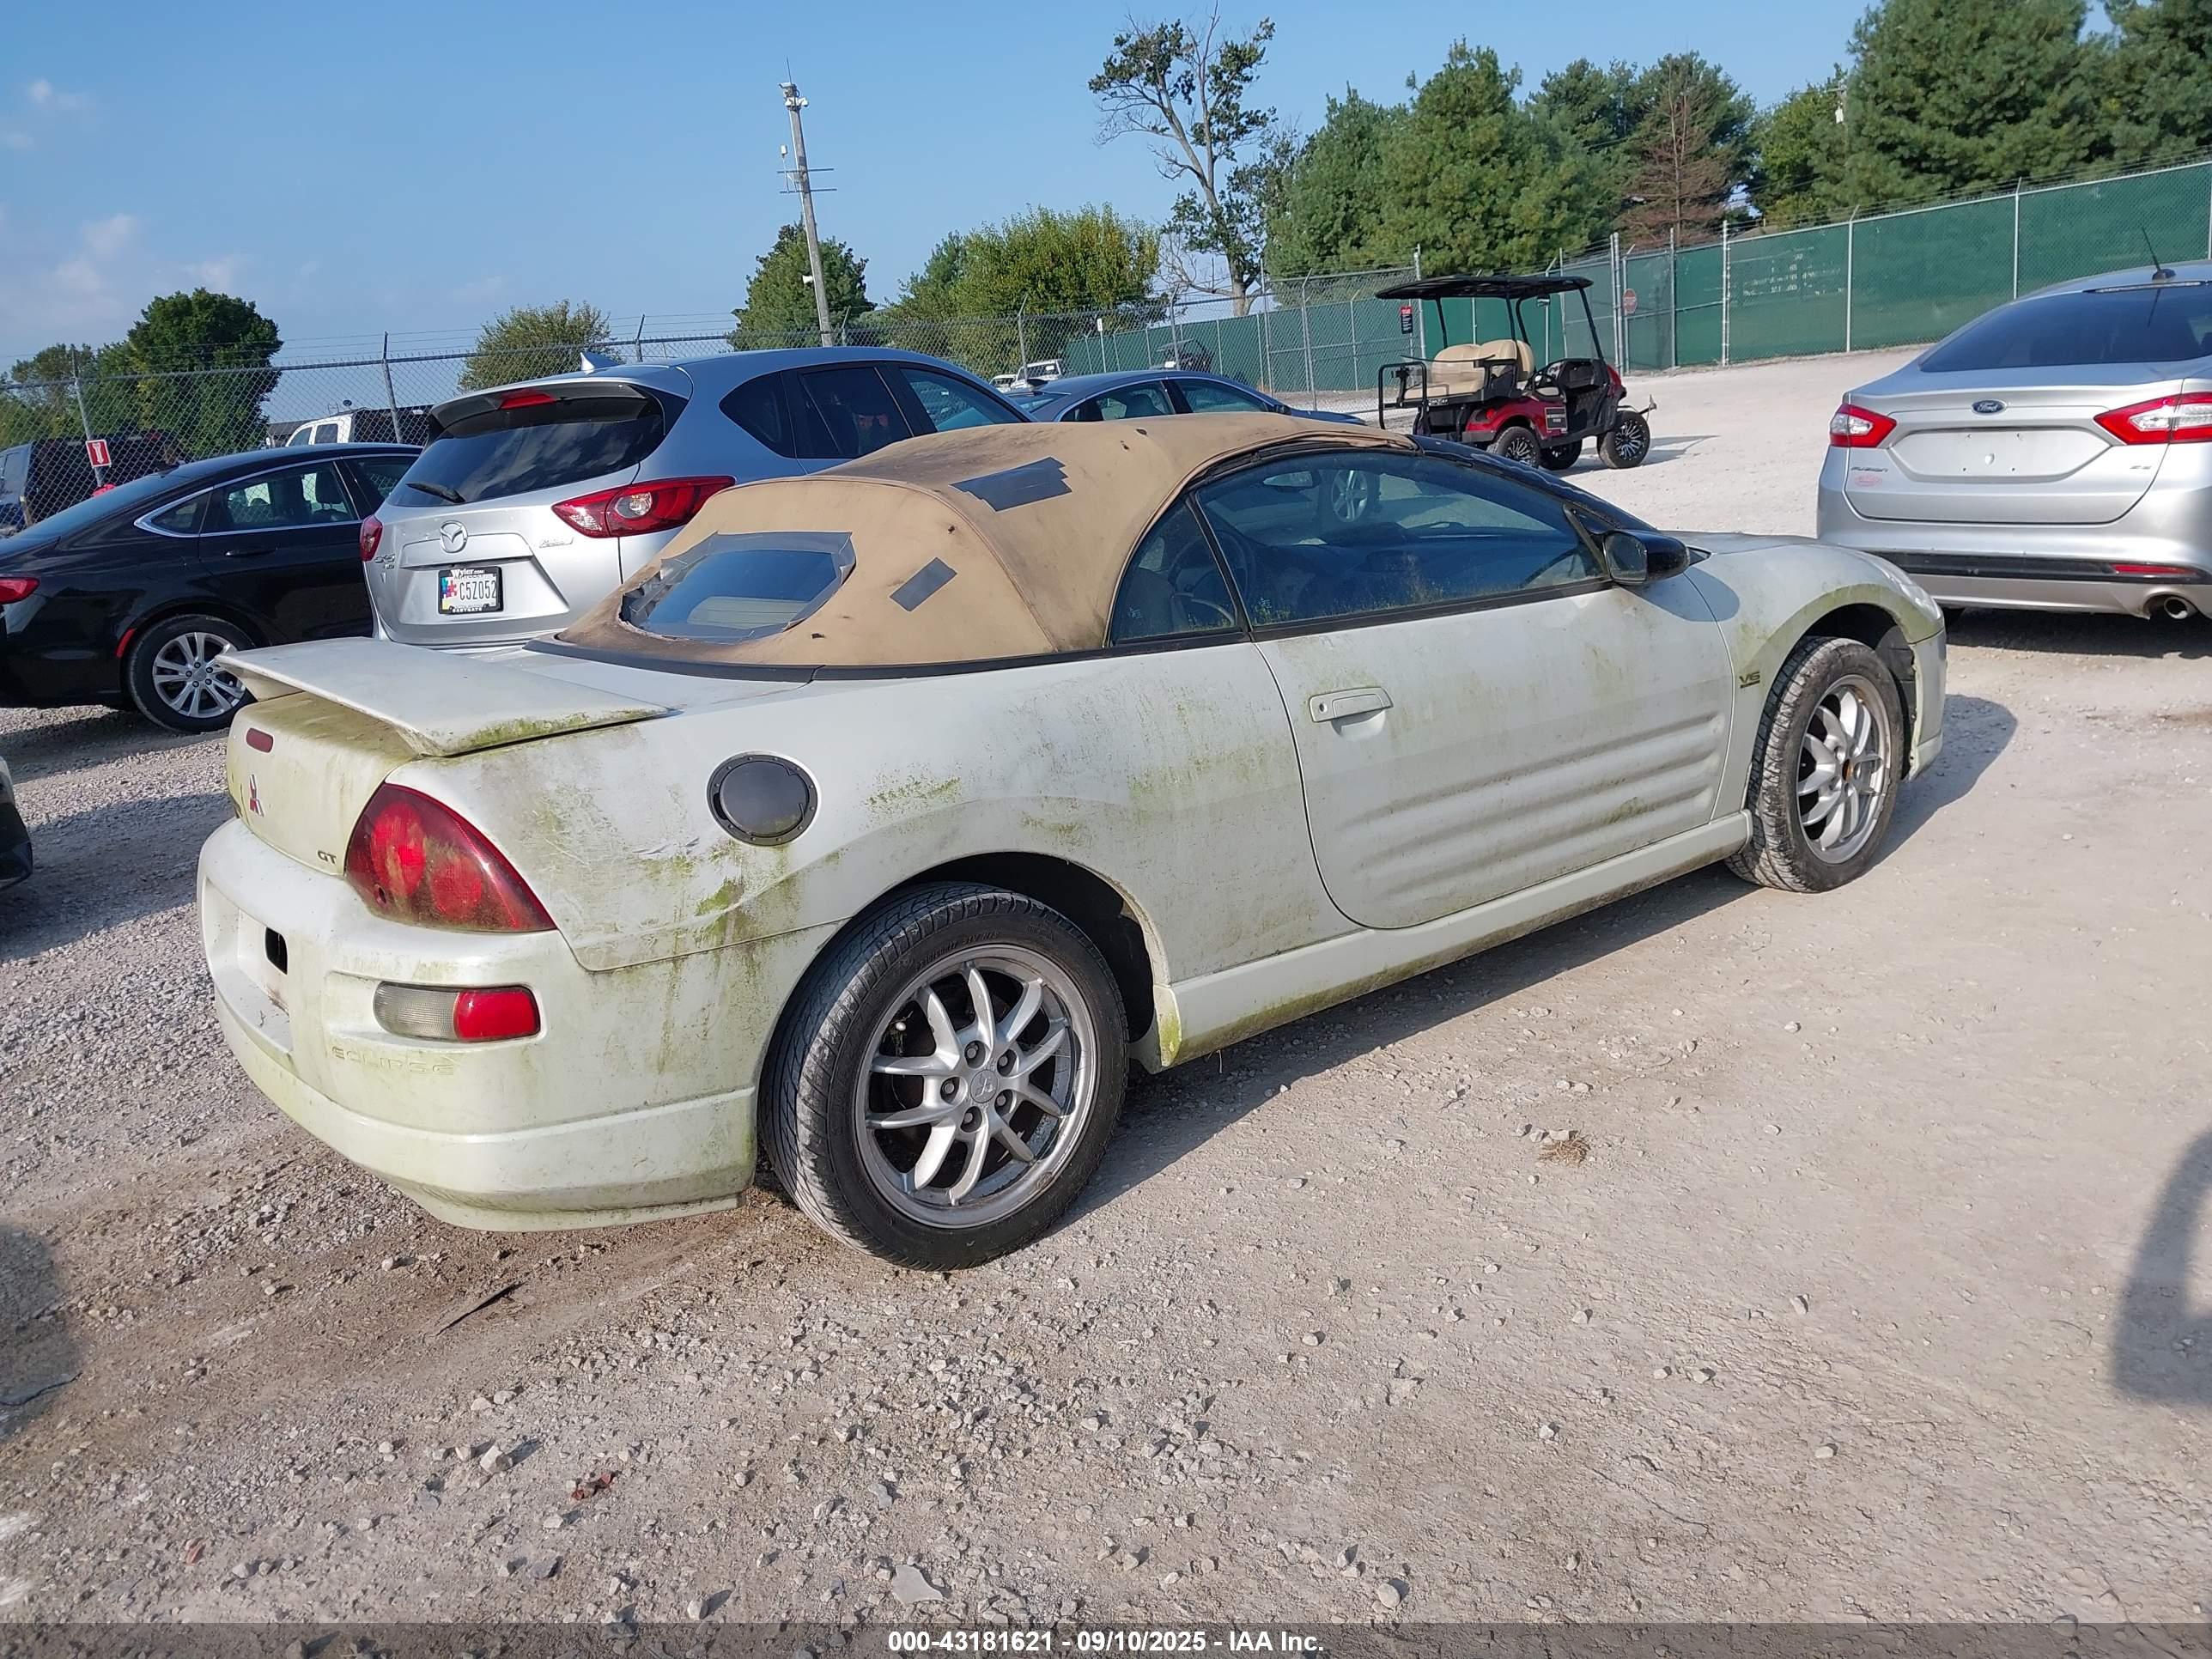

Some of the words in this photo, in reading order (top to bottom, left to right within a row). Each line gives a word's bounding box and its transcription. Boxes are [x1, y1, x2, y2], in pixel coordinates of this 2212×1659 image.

[1739, 672, 1760, 684] V6
[318, 851, 337, 864] GT
[331, 1046, 454, 1075] ECLIPSE
